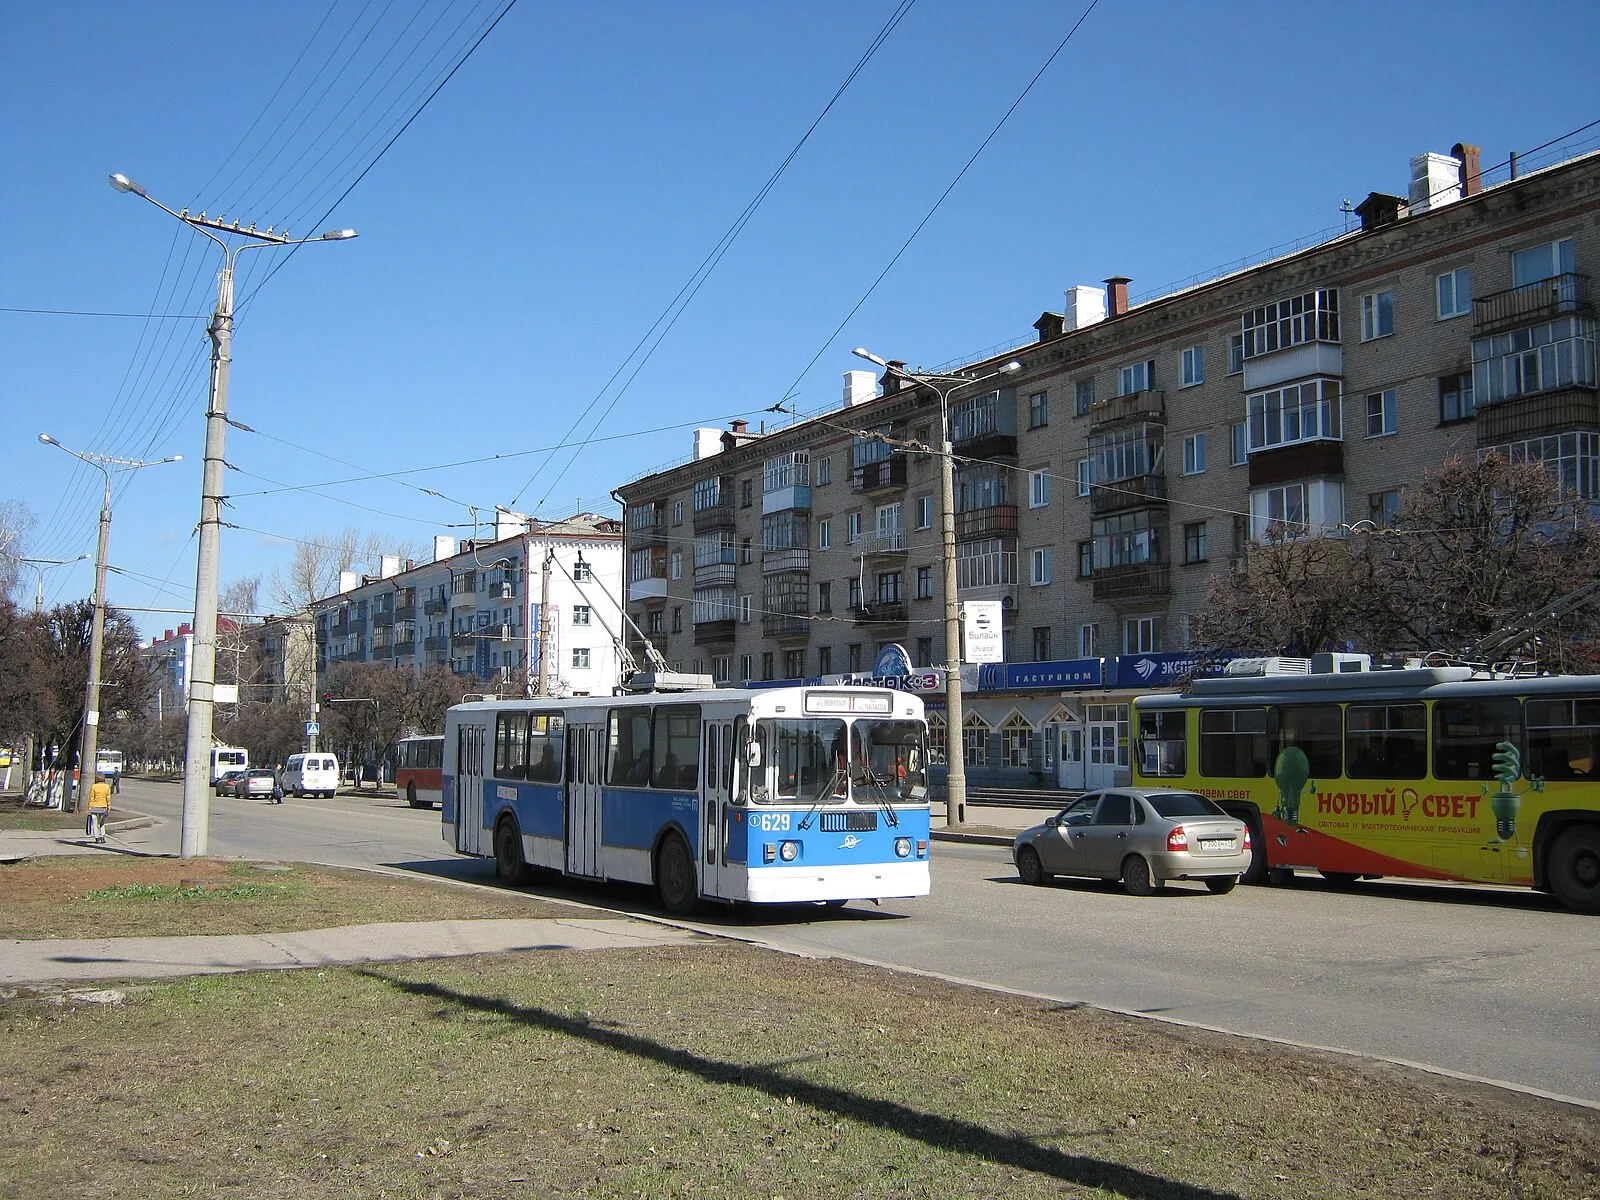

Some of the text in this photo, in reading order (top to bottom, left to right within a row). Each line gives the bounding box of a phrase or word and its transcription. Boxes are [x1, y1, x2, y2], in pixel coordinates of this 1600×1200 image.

[1016, 671, 1092, 683] ГАСТРОНОМ
[1227, 789, 1251, 799] свет
[1316, 787, 1482, 819] НОВЫЙ СВЕТ
[761, 813, 791, 831] 629
[1318, 820, 1349, 829] СВЕТОВАЯ
[1361, 822, 1434, 832] ЭЛЕКТРОТЕХНИЧЕСКАЯ
[1438, 825, 1480, 834] ПРОДУКЦИЯ
